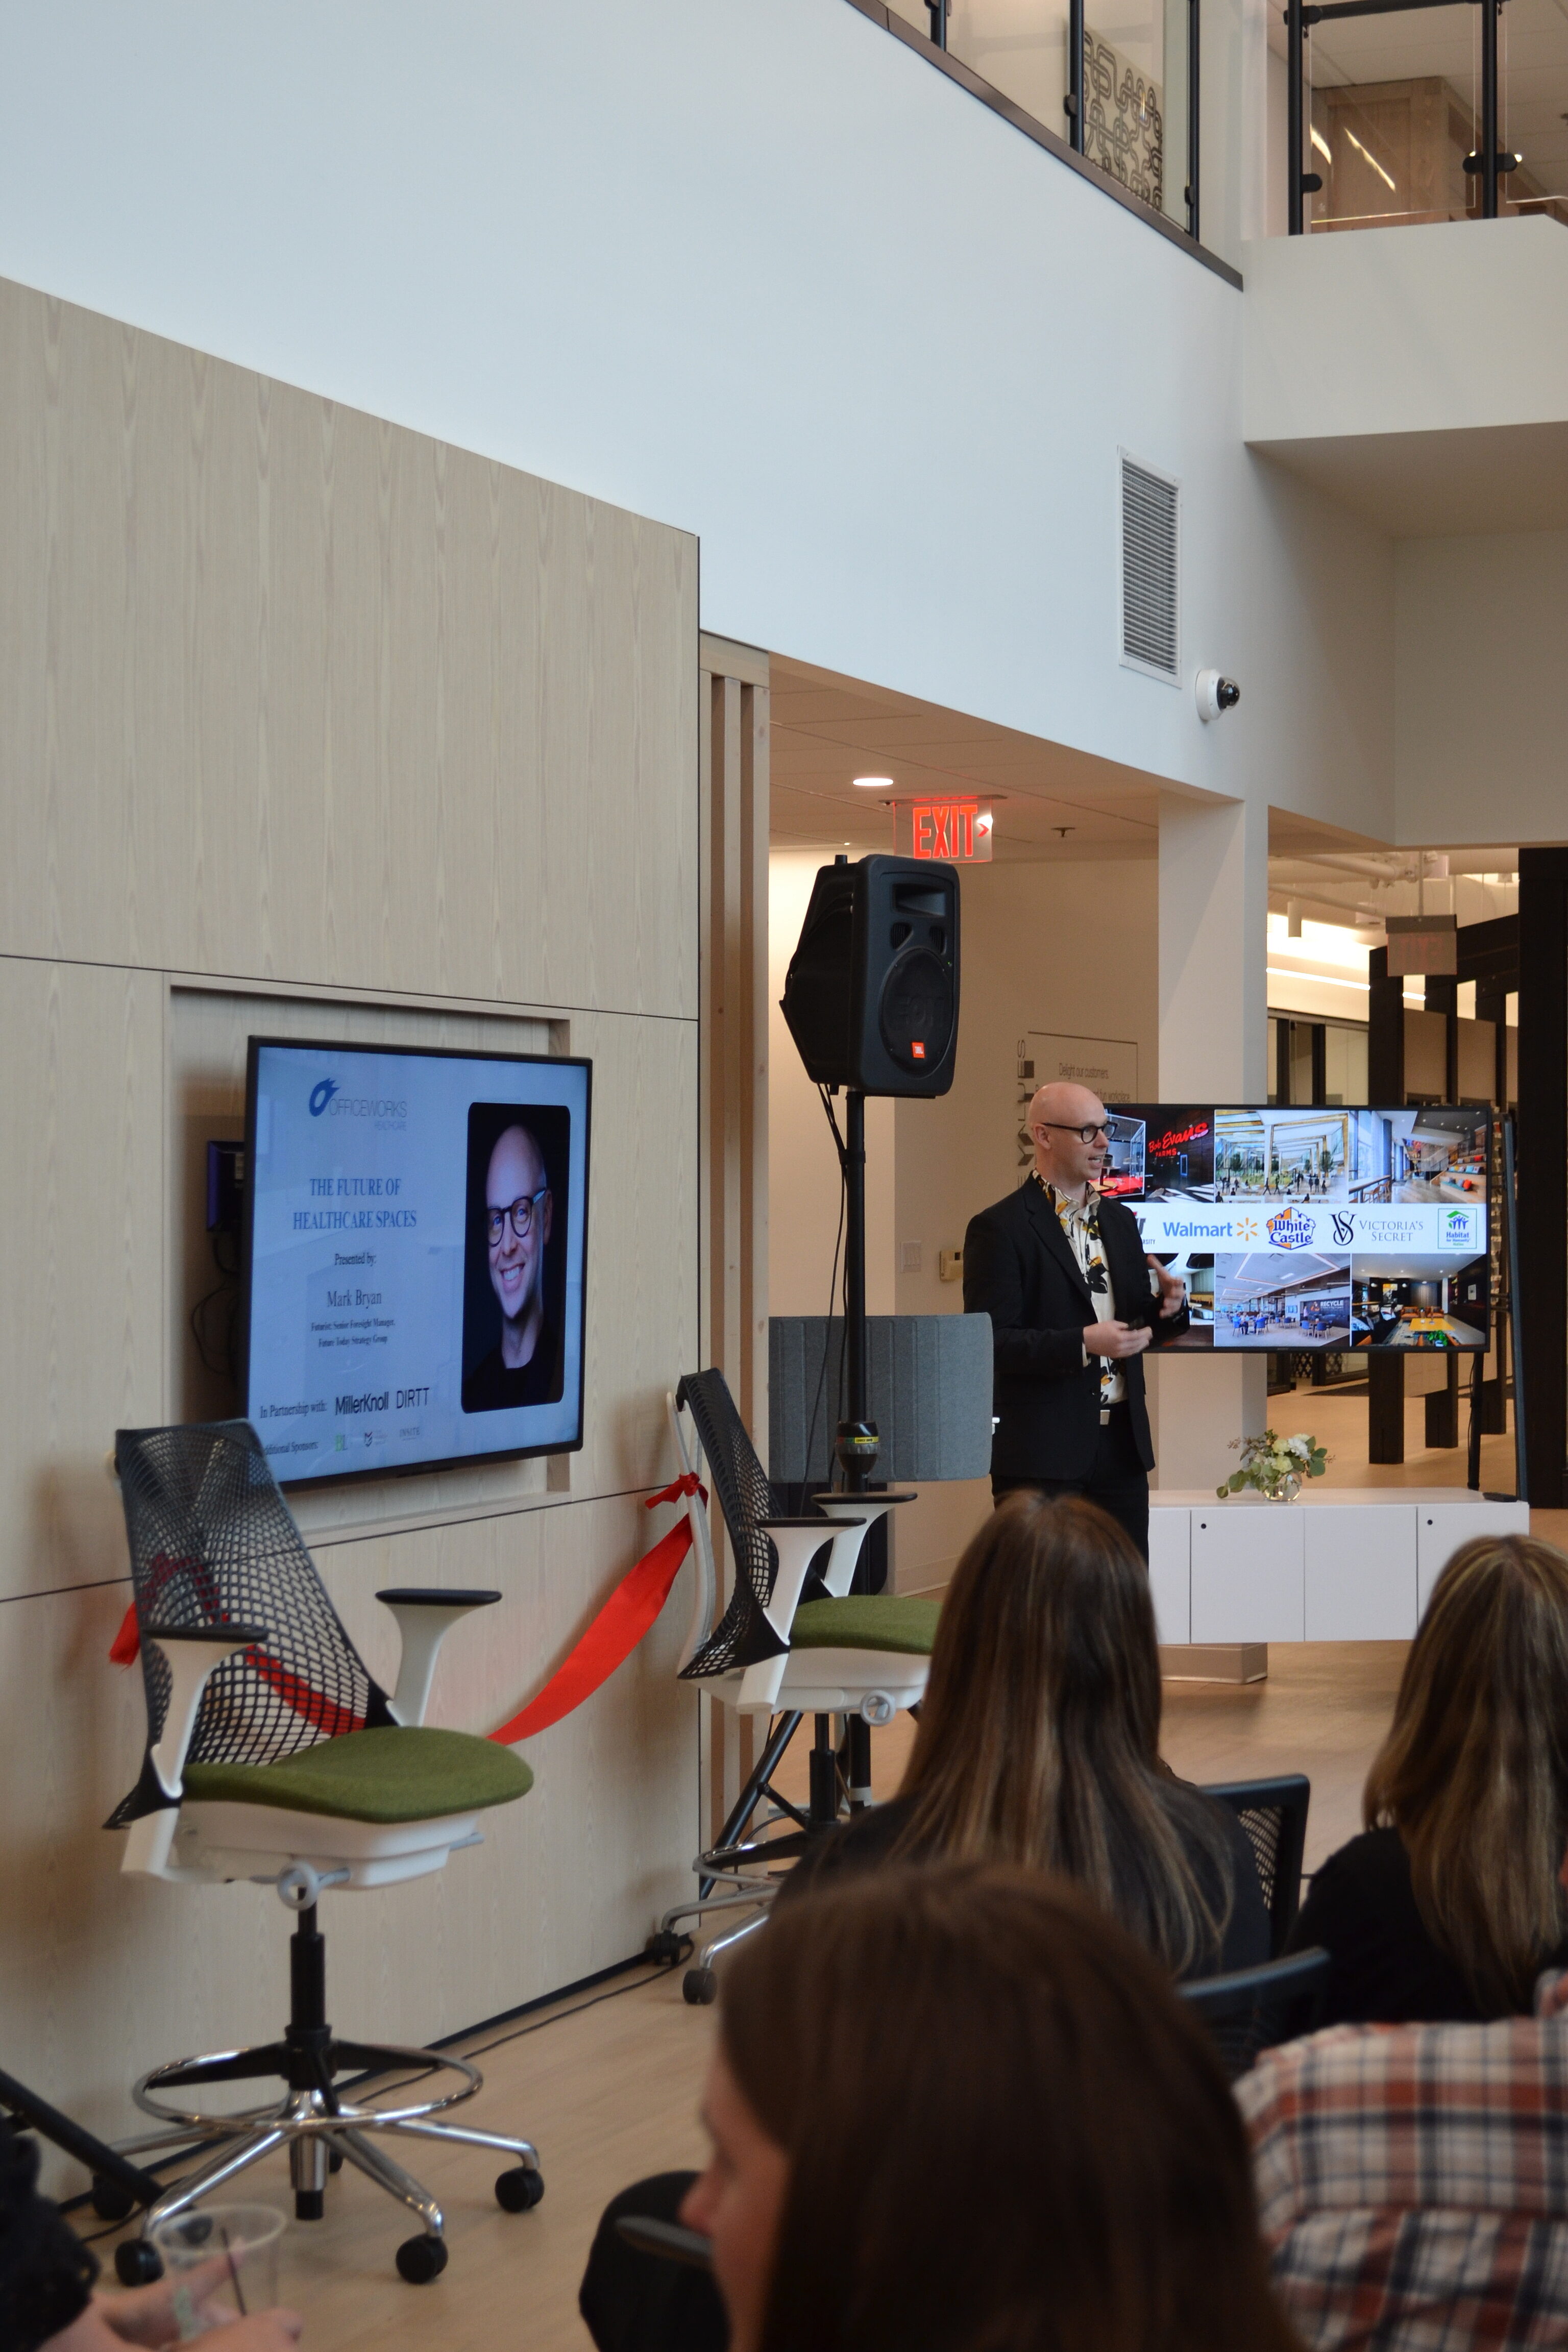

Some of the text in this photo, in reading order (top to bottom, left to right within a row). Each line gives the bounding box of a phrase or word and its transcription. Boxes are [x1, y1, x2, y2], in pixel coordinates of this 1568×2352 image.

[913, 804, 978, 859] EXIT
[329, 1098, 407, 1118] OFFICEWORKS
[310, 1178, 402, 1196] THE FUTURE OF
[293, 1210, 417, 1230] HEALTHCARE SPACES
[1272, 1220, 1310, 1233] White
[1359, 1220, 1424, 1230] VICTORIA'S
[1163, 1222, 1233, 1237] Walmart
[1270, 1232, 1311, 1243] Castle
[1371, 1232, 1413, 1241] SECRET
[334, 1252, 376, 1266] Presented by:
[327, 1289, 382, 1309] Mark Bryan
[260, 1406, 268, 1418] In
[270, 1401, 309, 1417] Partnership
[335, 1391, 389, 1415] MillerKnoll
[396, 1387, 430, 1409] DIRTT
